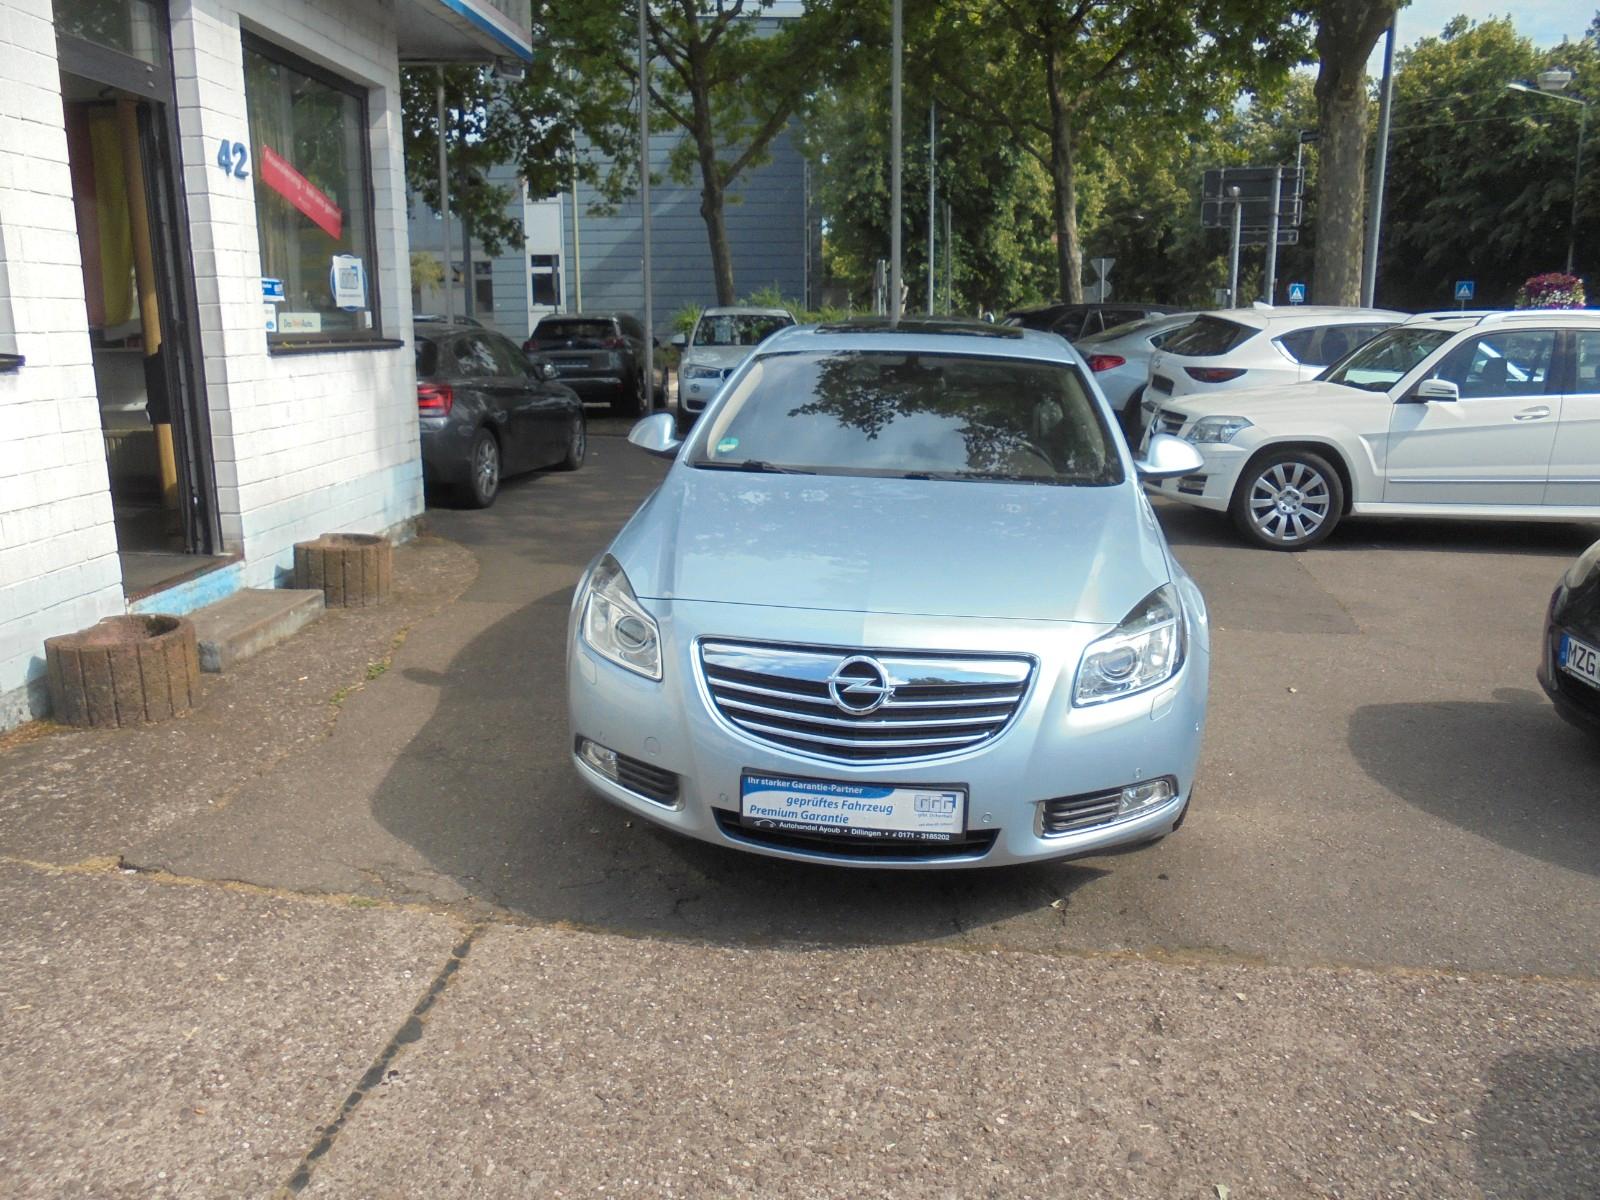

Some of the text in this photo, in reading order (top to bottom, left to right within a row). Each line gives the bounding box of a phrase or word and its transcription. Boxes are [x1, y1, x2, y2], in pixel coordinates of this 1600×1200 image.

[217, 139, 249, 180] 42
[1567, 641, 1596, 677] MZG
[747, 777, 863, 794] Ihr starker Garantie-Partner
[750, 804, 849, 824] Premium Garantie
[786, 796, 894, 816] geprüftes Fahrzeug
[778, 822, 818, 831] Autohandel
[818, 825, 841, 834] Ayoub
[851, 828, 882, 838] Dillingen
[898, 831, 915, 839] 0171
